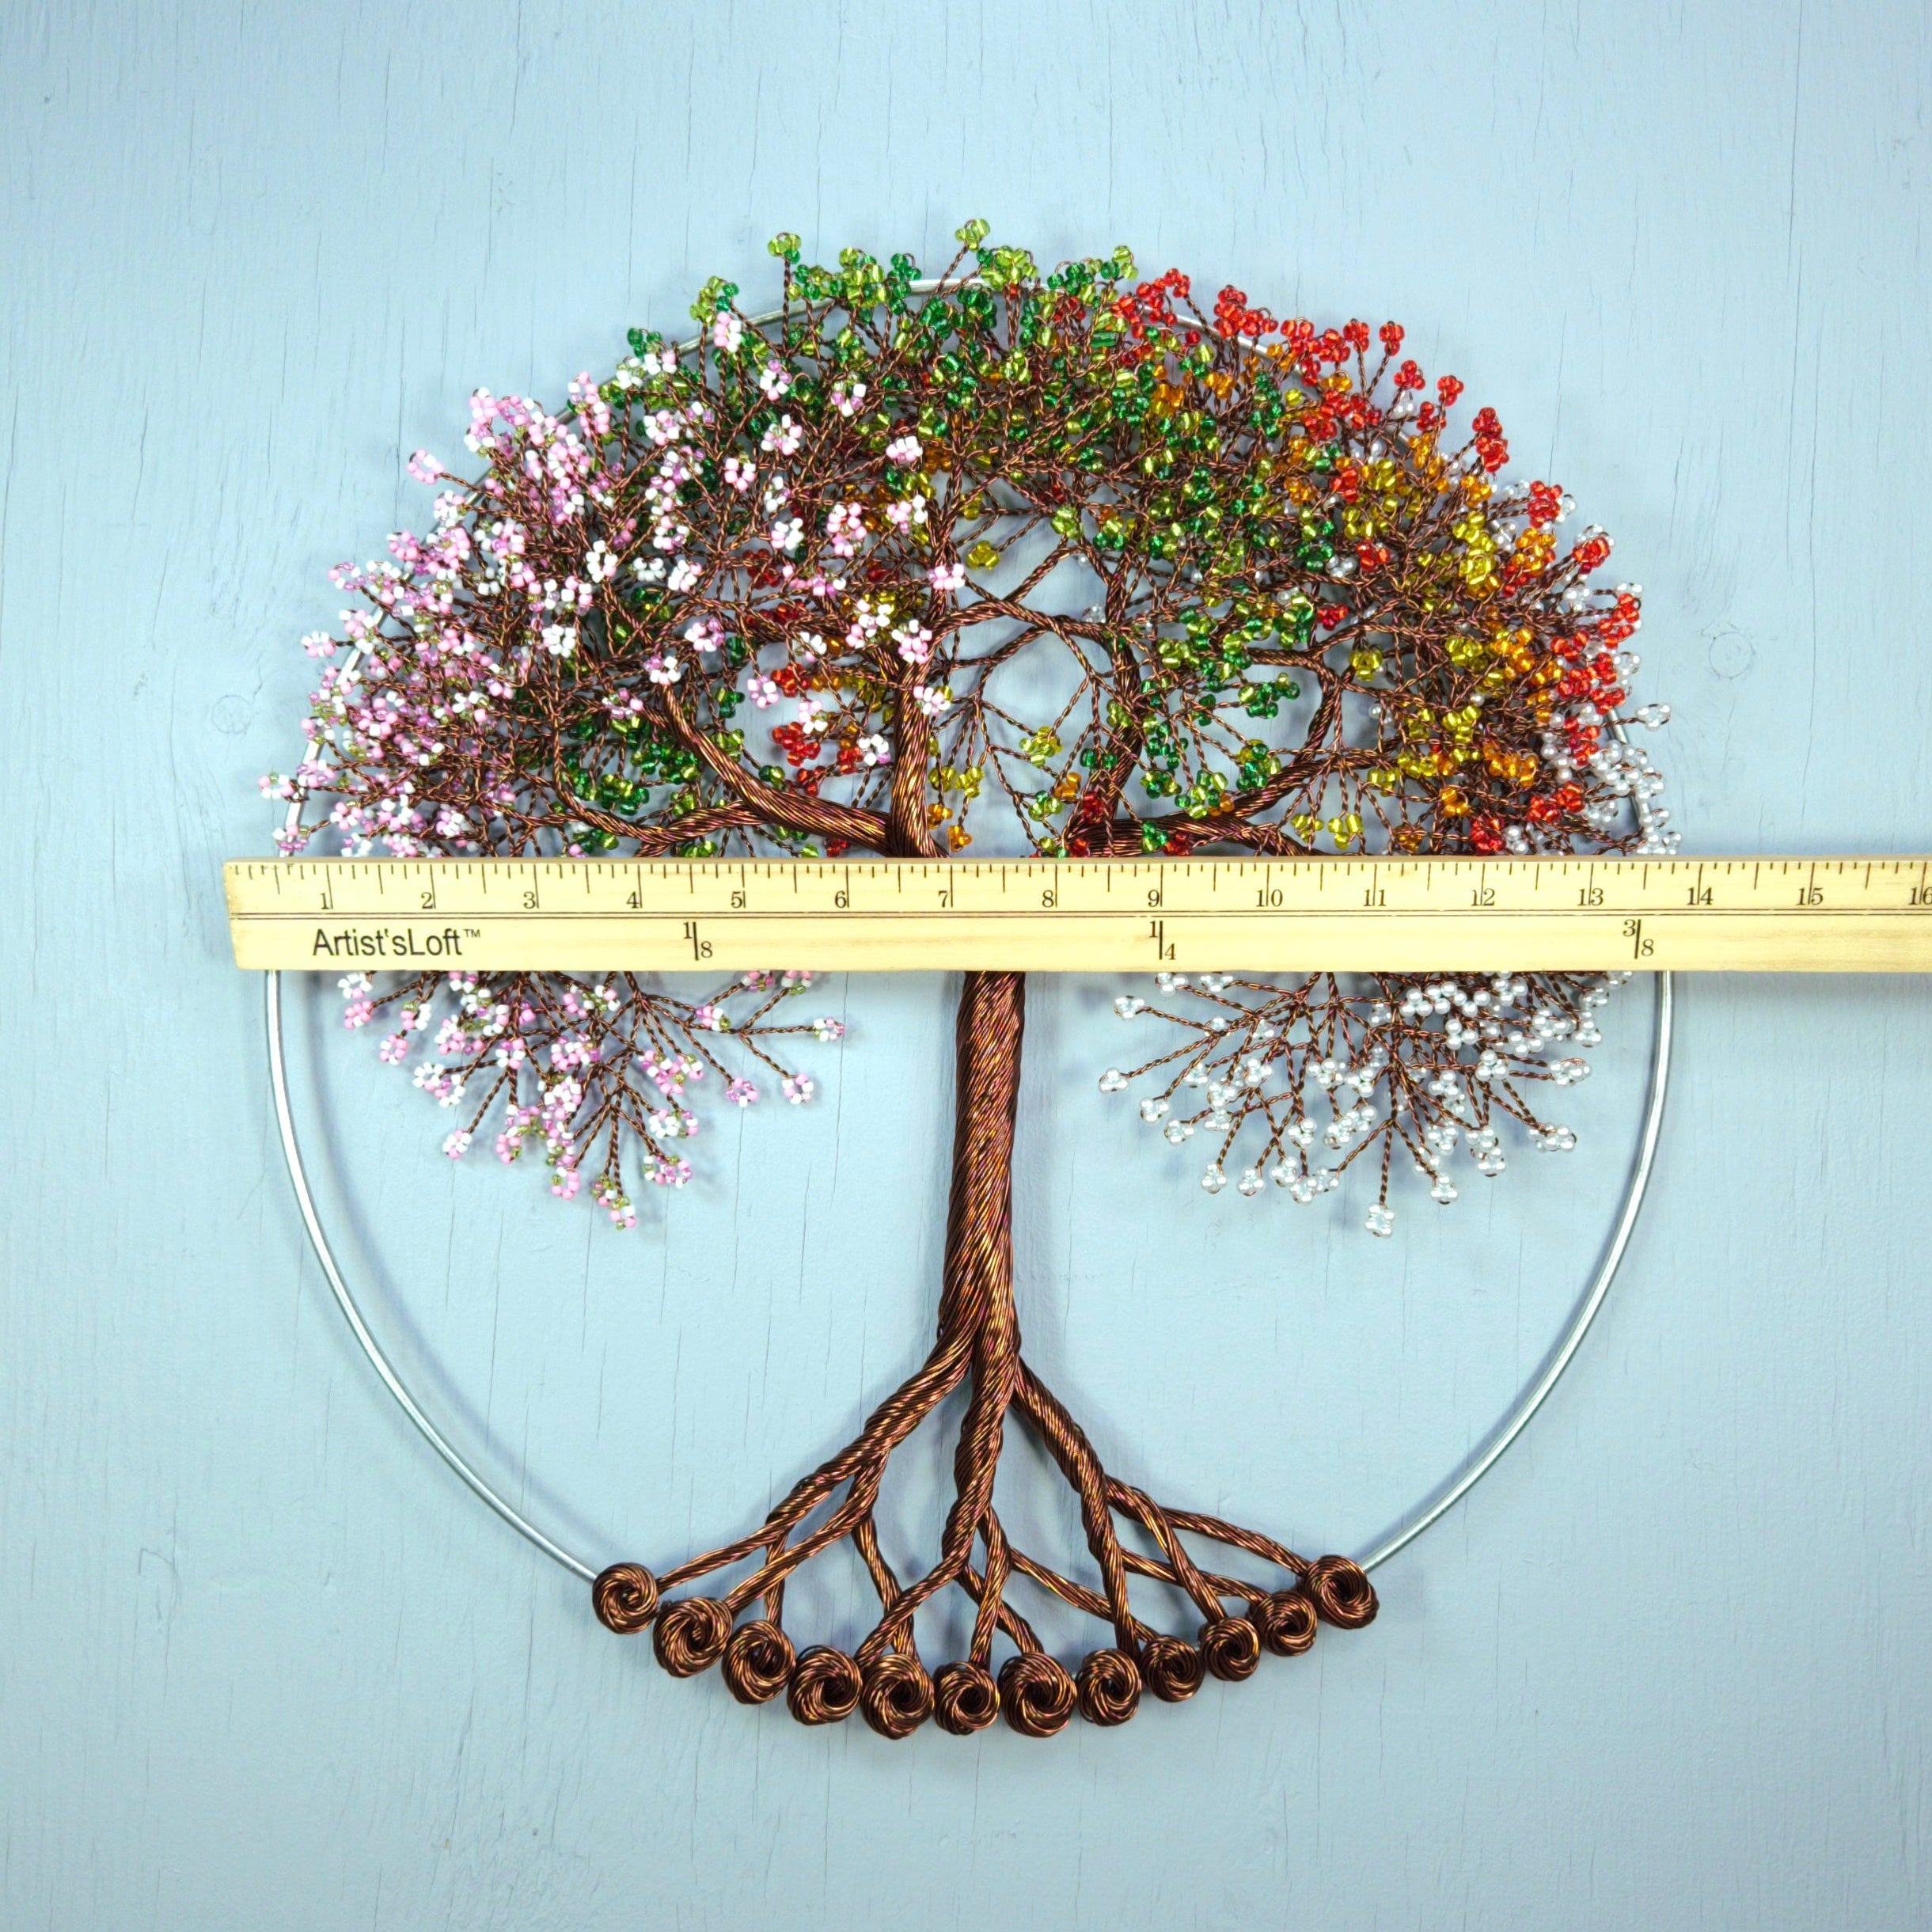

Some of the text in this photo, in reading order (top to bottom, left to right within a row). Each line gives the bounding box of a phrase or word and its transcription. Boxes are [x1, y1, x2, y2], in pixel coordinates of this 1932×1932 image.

[321, 892, 331, 910] 1
[421, 892, 434, 909] 2
[523, 892, 536, 909] 3
[626, 891, 640, 909] 4
[731, 891, 743, 909] 5
[834, 890, 847, 908] 6
[938, 890, 948, 908] 7
[1042, 890, 1054, 908] 8
[1148, 890, 1160, 907] 9
[1255, 889, 1284, 907] 10
[1363, 889, 1387, 906] 11
[1471, 889, 1496, 906] 12
[1577, 888, 1604, 906] 13
[1687, 887, 1714, 905] 14
[1796, 887, 1824, 905] 15
